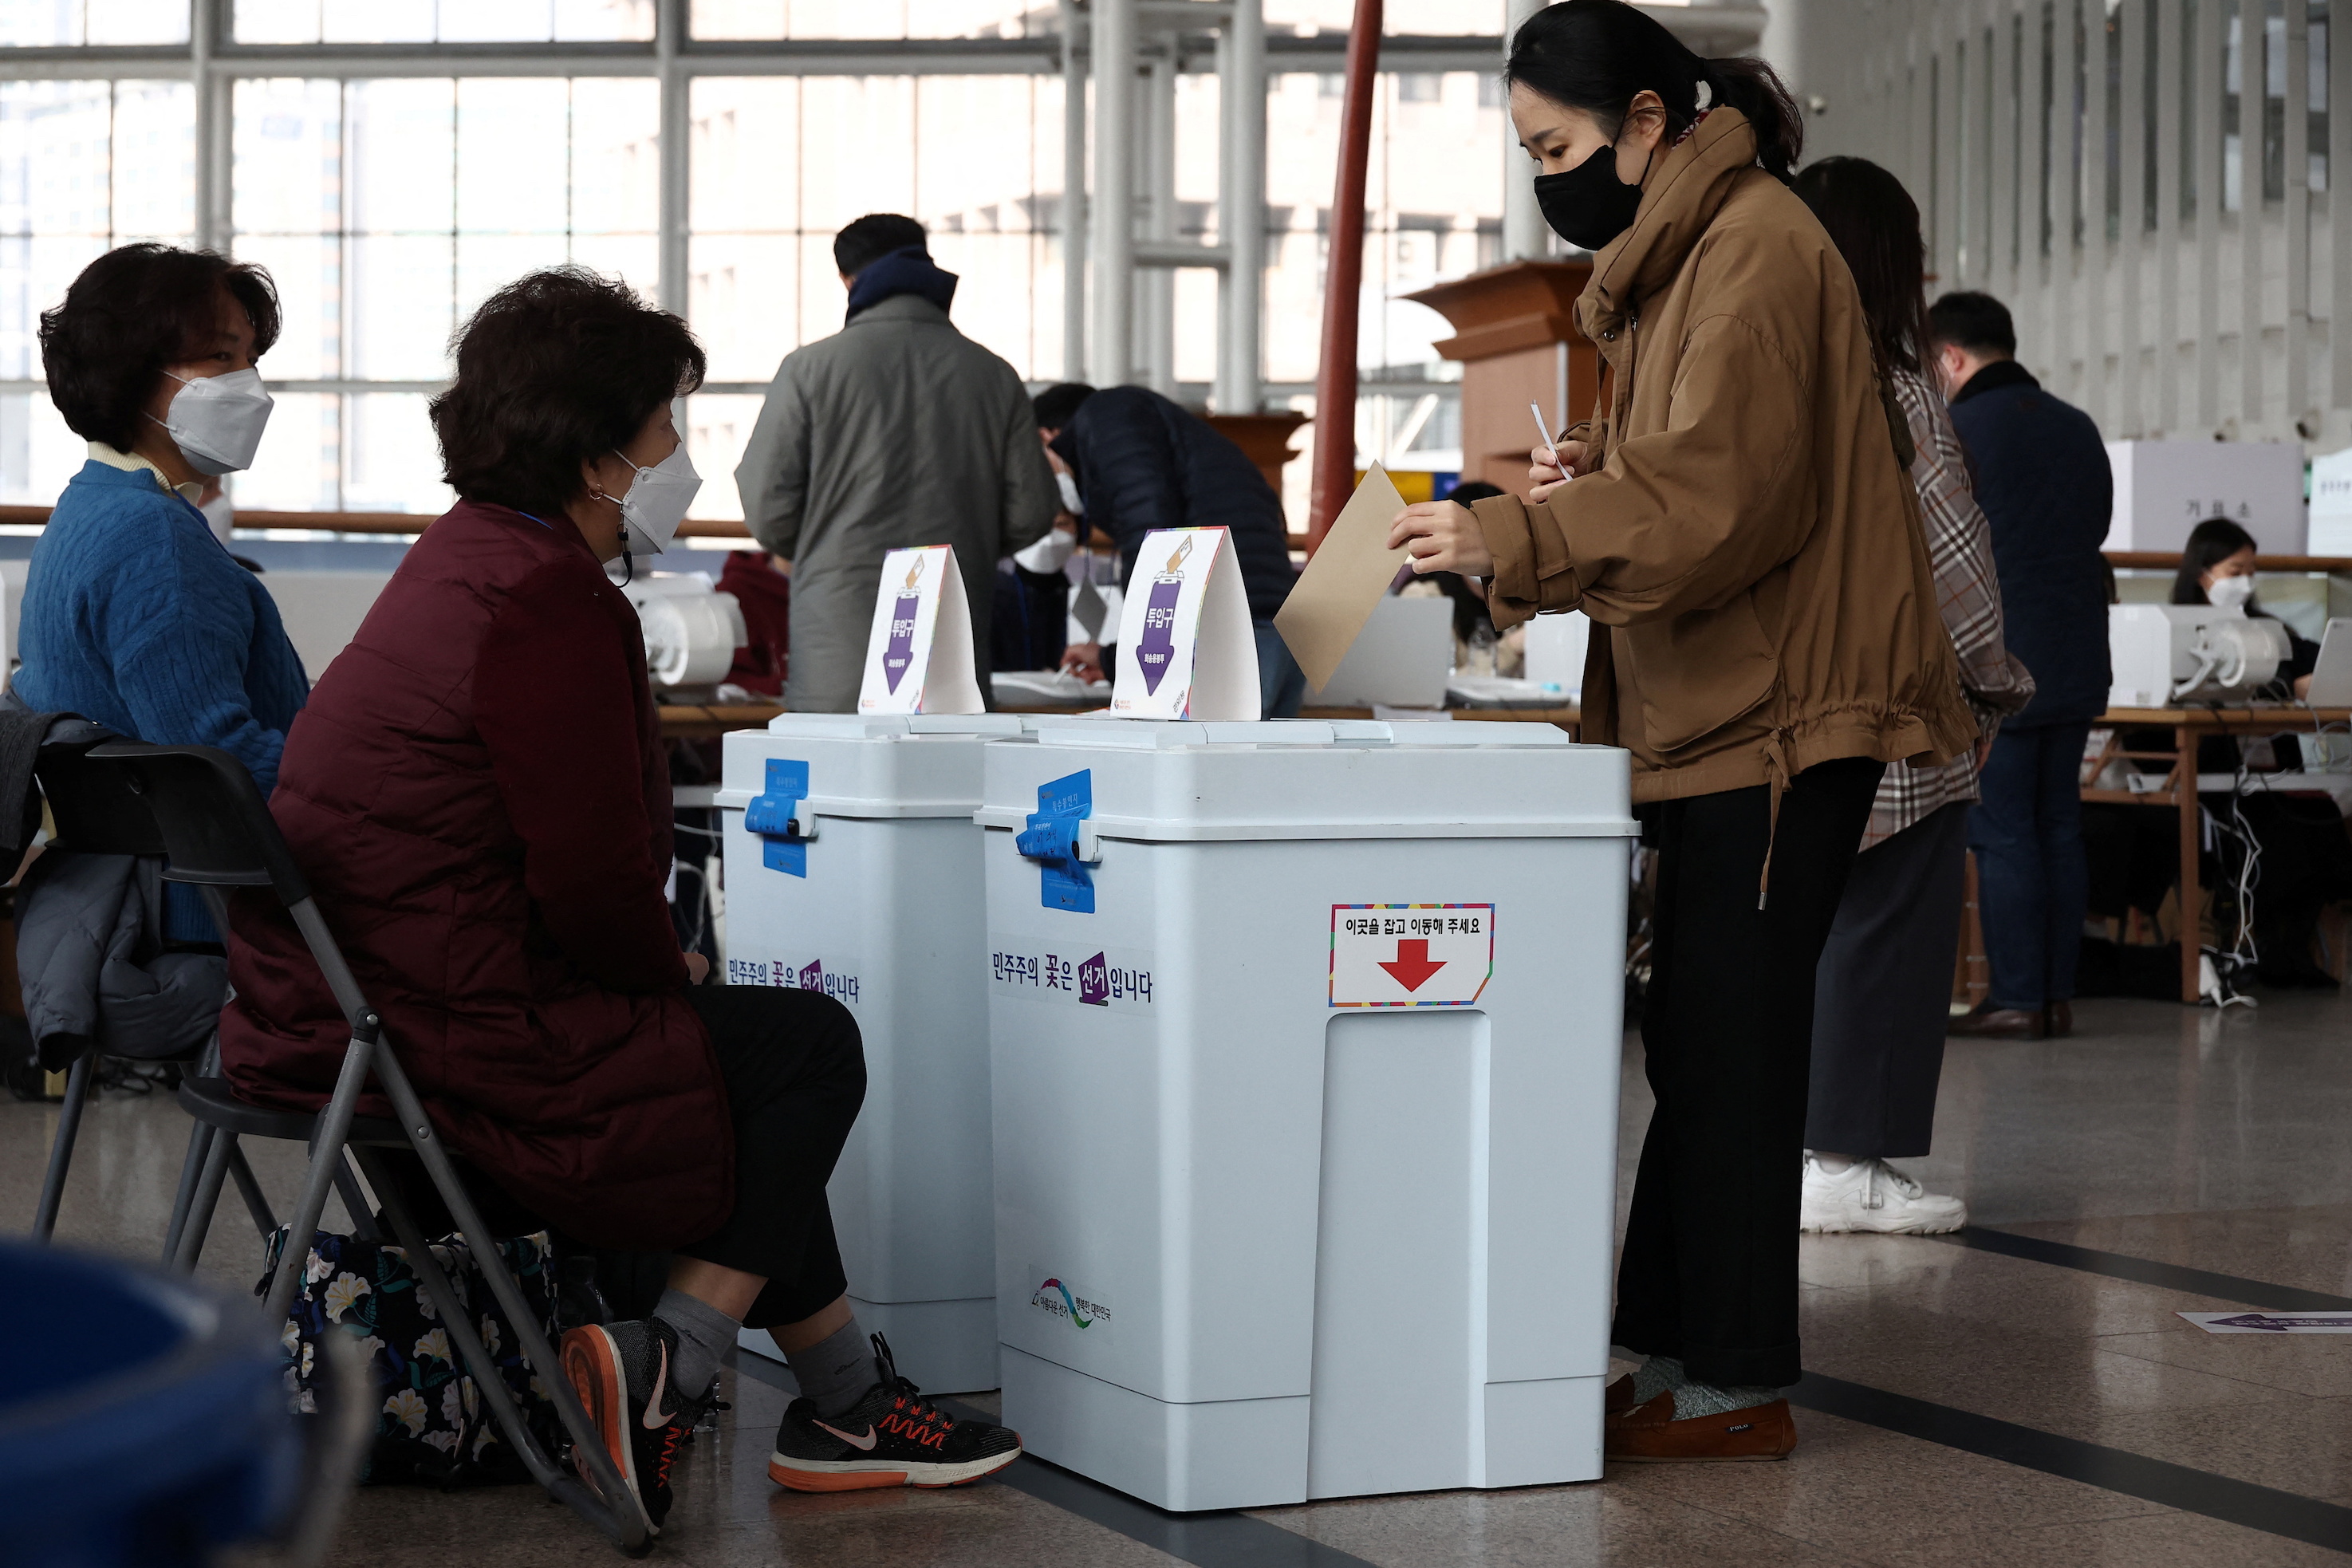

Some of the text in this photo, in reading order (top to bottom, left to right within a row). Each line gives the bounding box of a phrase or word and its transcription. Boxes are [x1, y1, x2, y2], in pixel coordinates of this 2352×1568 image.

[892, 618, 914, 638] 투입구
[1146, 608, 1173, 628] 투입구
[1052, 793, 1078, 812] 특수봉인지
[1346, 918, 1480, 935] 이곳을 잡고 이동해 주세요
[729, 959, 766, 986] 민주주의
[993, 951, 1152, 1003] 민주주의 꽃은 선거입니다
[1040, 1296, 1068, 1319] 아름다운 선거
[1075, 1297, 1111, 1322] 행복한 대한민국
